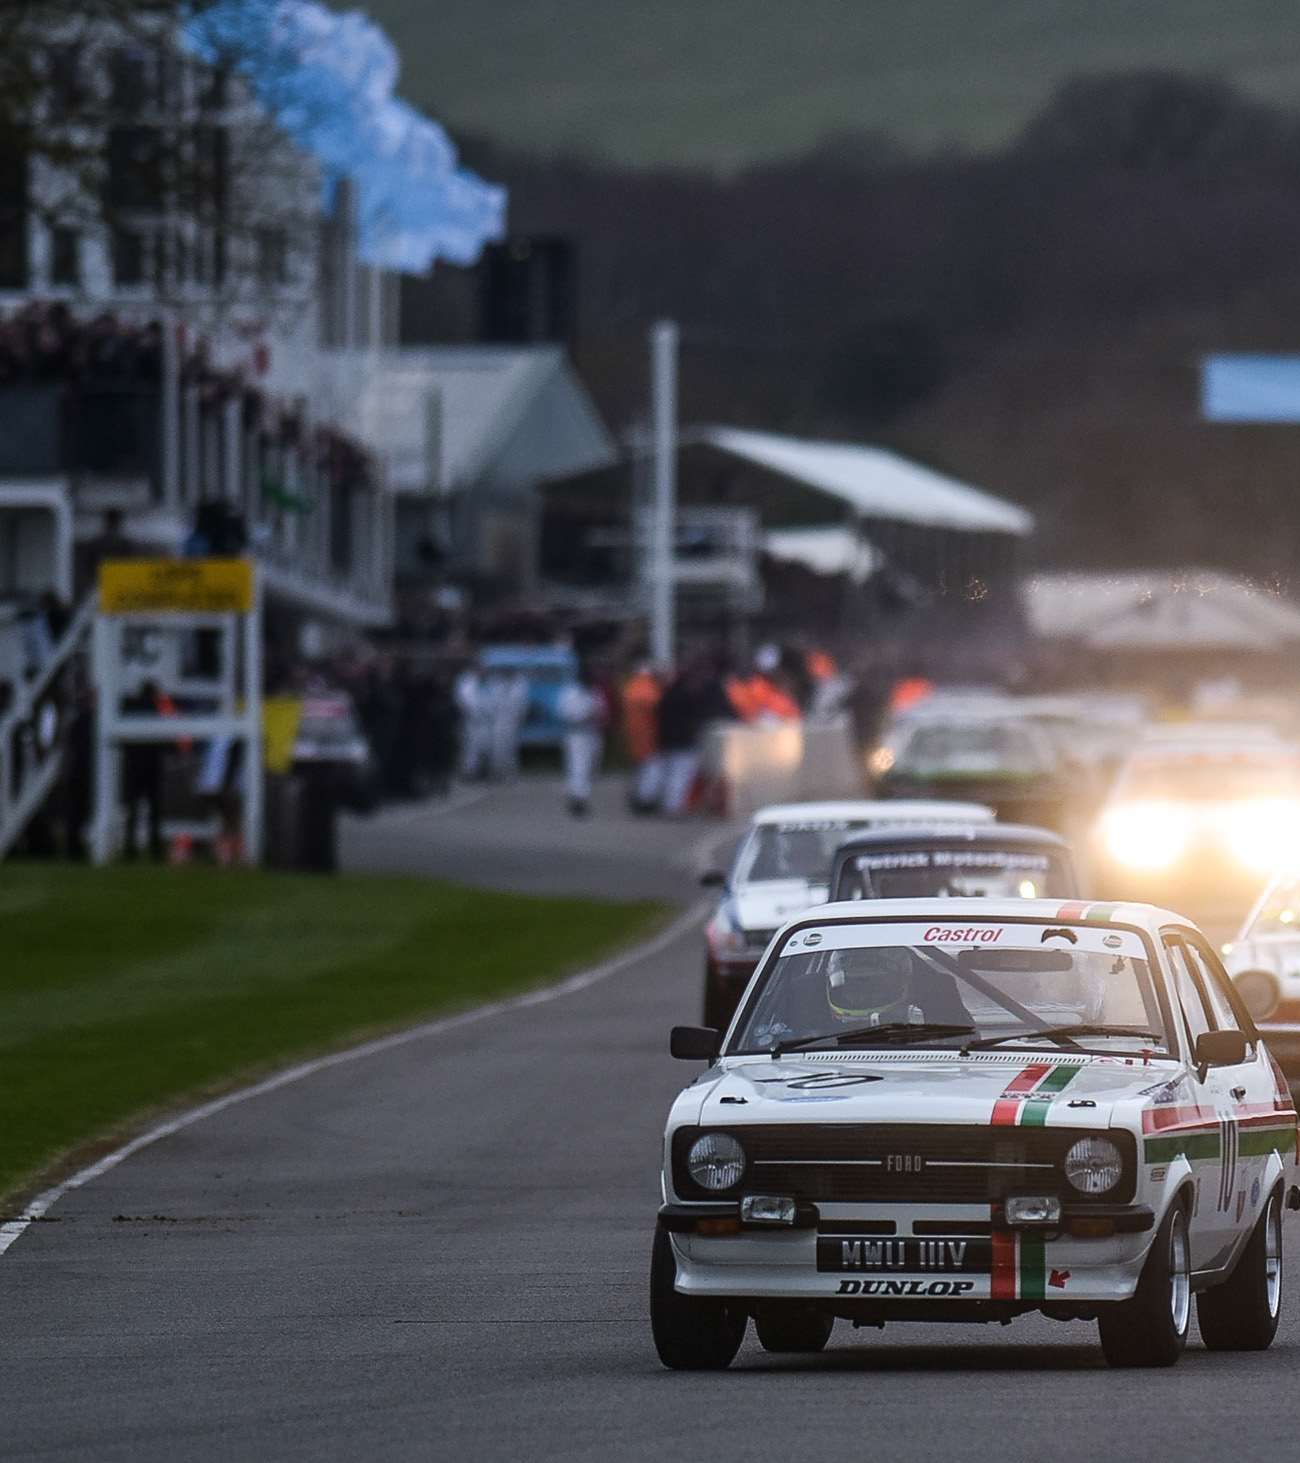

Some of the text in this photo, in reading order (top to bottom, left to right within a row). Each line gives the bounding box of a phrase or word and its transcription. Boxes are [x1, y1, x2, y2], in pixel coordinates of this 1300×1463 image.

[923, 926, 1003, 943] Castrol
[887, 1154, 922, 1173] FORD
[835, 1280, 975, 1297] DUNLOP
